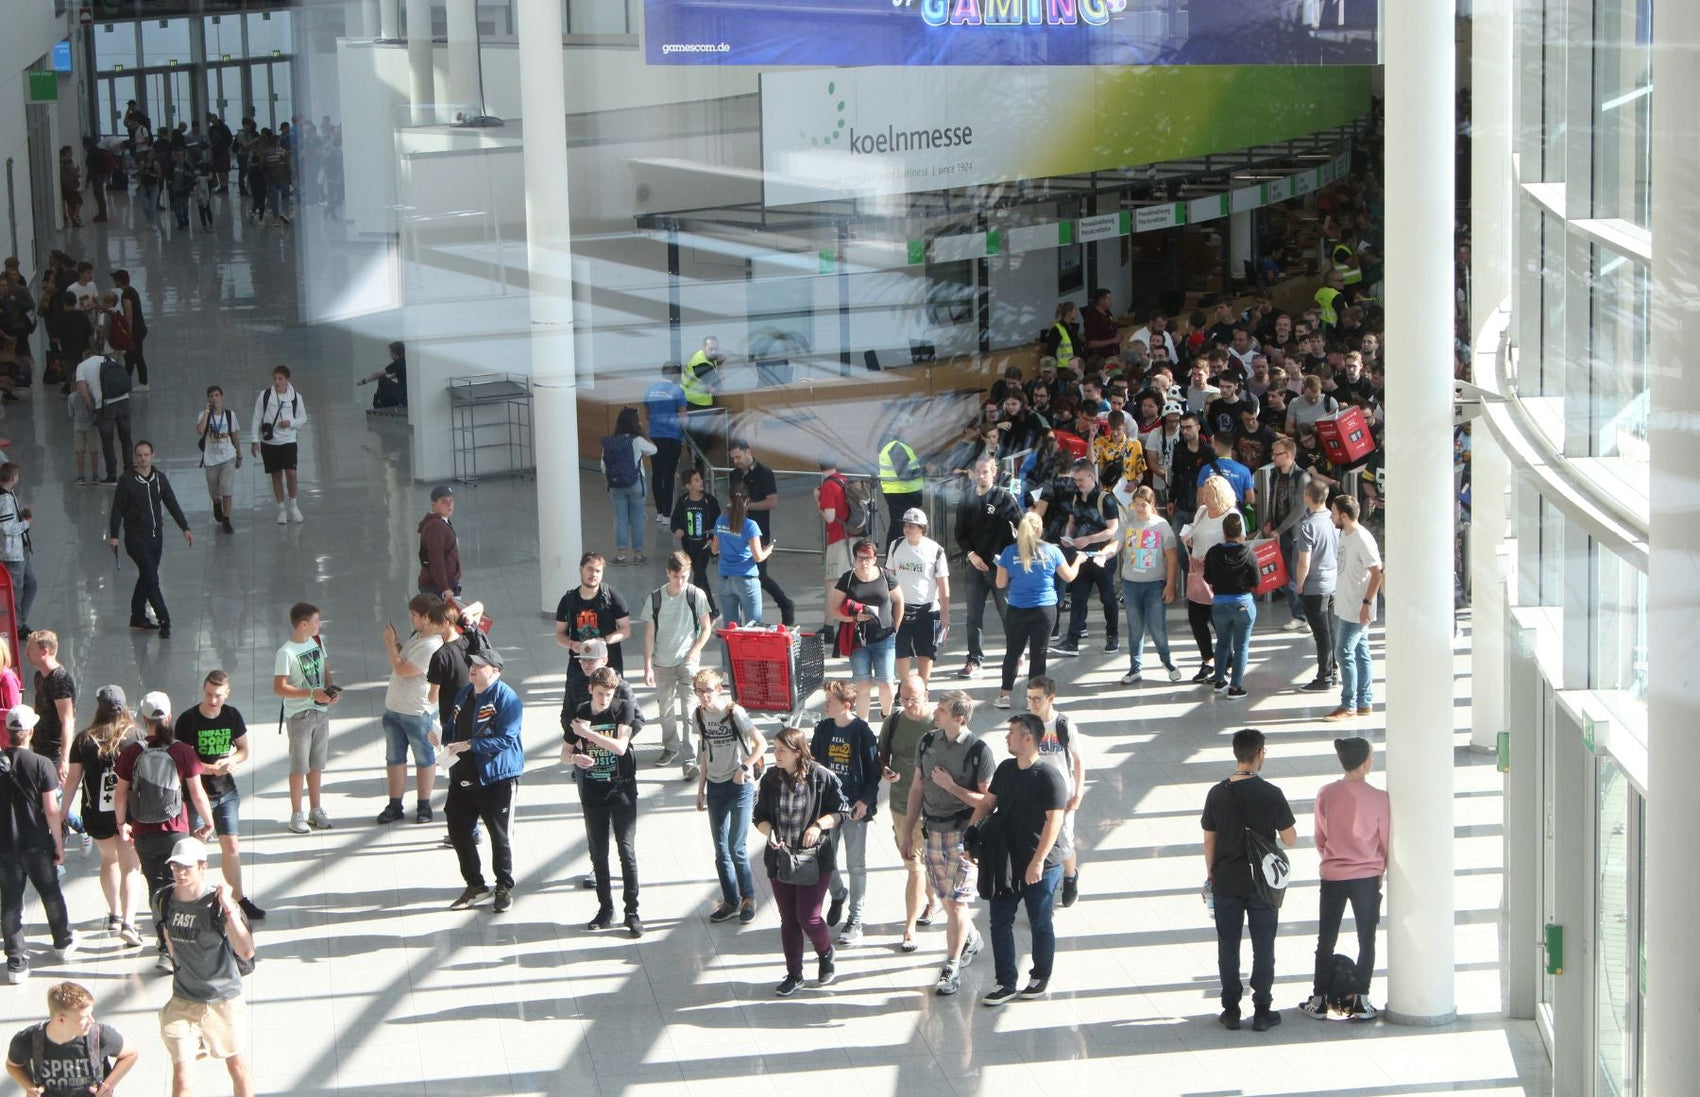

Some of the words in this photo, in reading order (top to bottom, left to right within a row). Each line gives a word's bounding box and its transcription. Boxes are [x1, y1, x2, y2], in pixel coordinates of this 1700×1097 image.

[921, 0, 1110, 26] GAMING
[662, 42, 731, 54] gamescom.de
[850, 124, 973, 155] koelnmesse
[938, 165, 955, 175] since
[957, 162, 973, 172] 1924
[1271, 858, 1288, 885] JD
[172, 912, 197, 928] FAST
[29, 1058, 90, 1079] SPRIT
